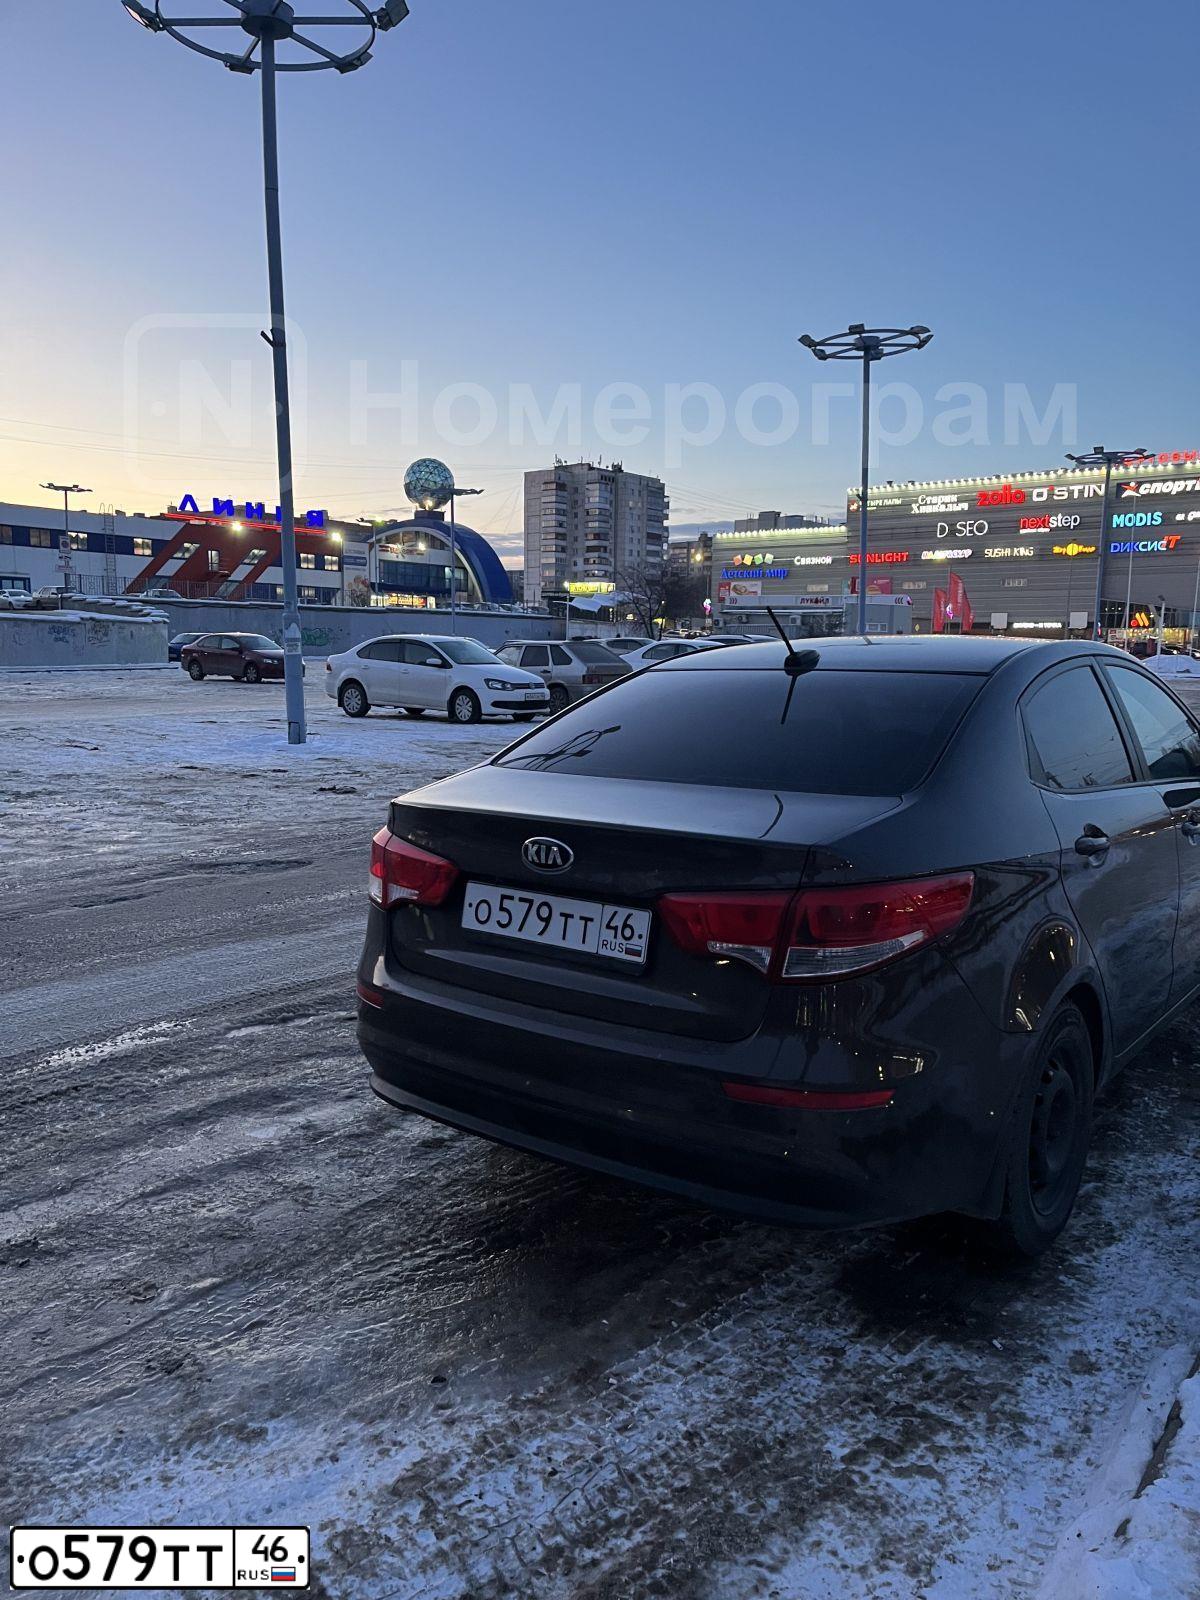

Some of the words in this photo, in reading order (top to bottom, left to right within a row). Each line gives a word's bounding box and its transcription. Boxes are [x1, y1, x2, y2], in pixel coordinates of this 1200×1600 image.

[976, 484, 1025, 506] zolla
[1019, 512, 1081, 530] nextstep
[1112, 511, 1163, 528] MODIS
[937, 523, 949, 538] D
[956, 520, 989, 537] SEO
[984, 547, 1011, 558] SUSHI
[1013, 546, 1034, 557] KING
[527, 843, 563, 866] KIA
[605, 910, 635, 941] 46
[601, 940, 624, 953] RUS
